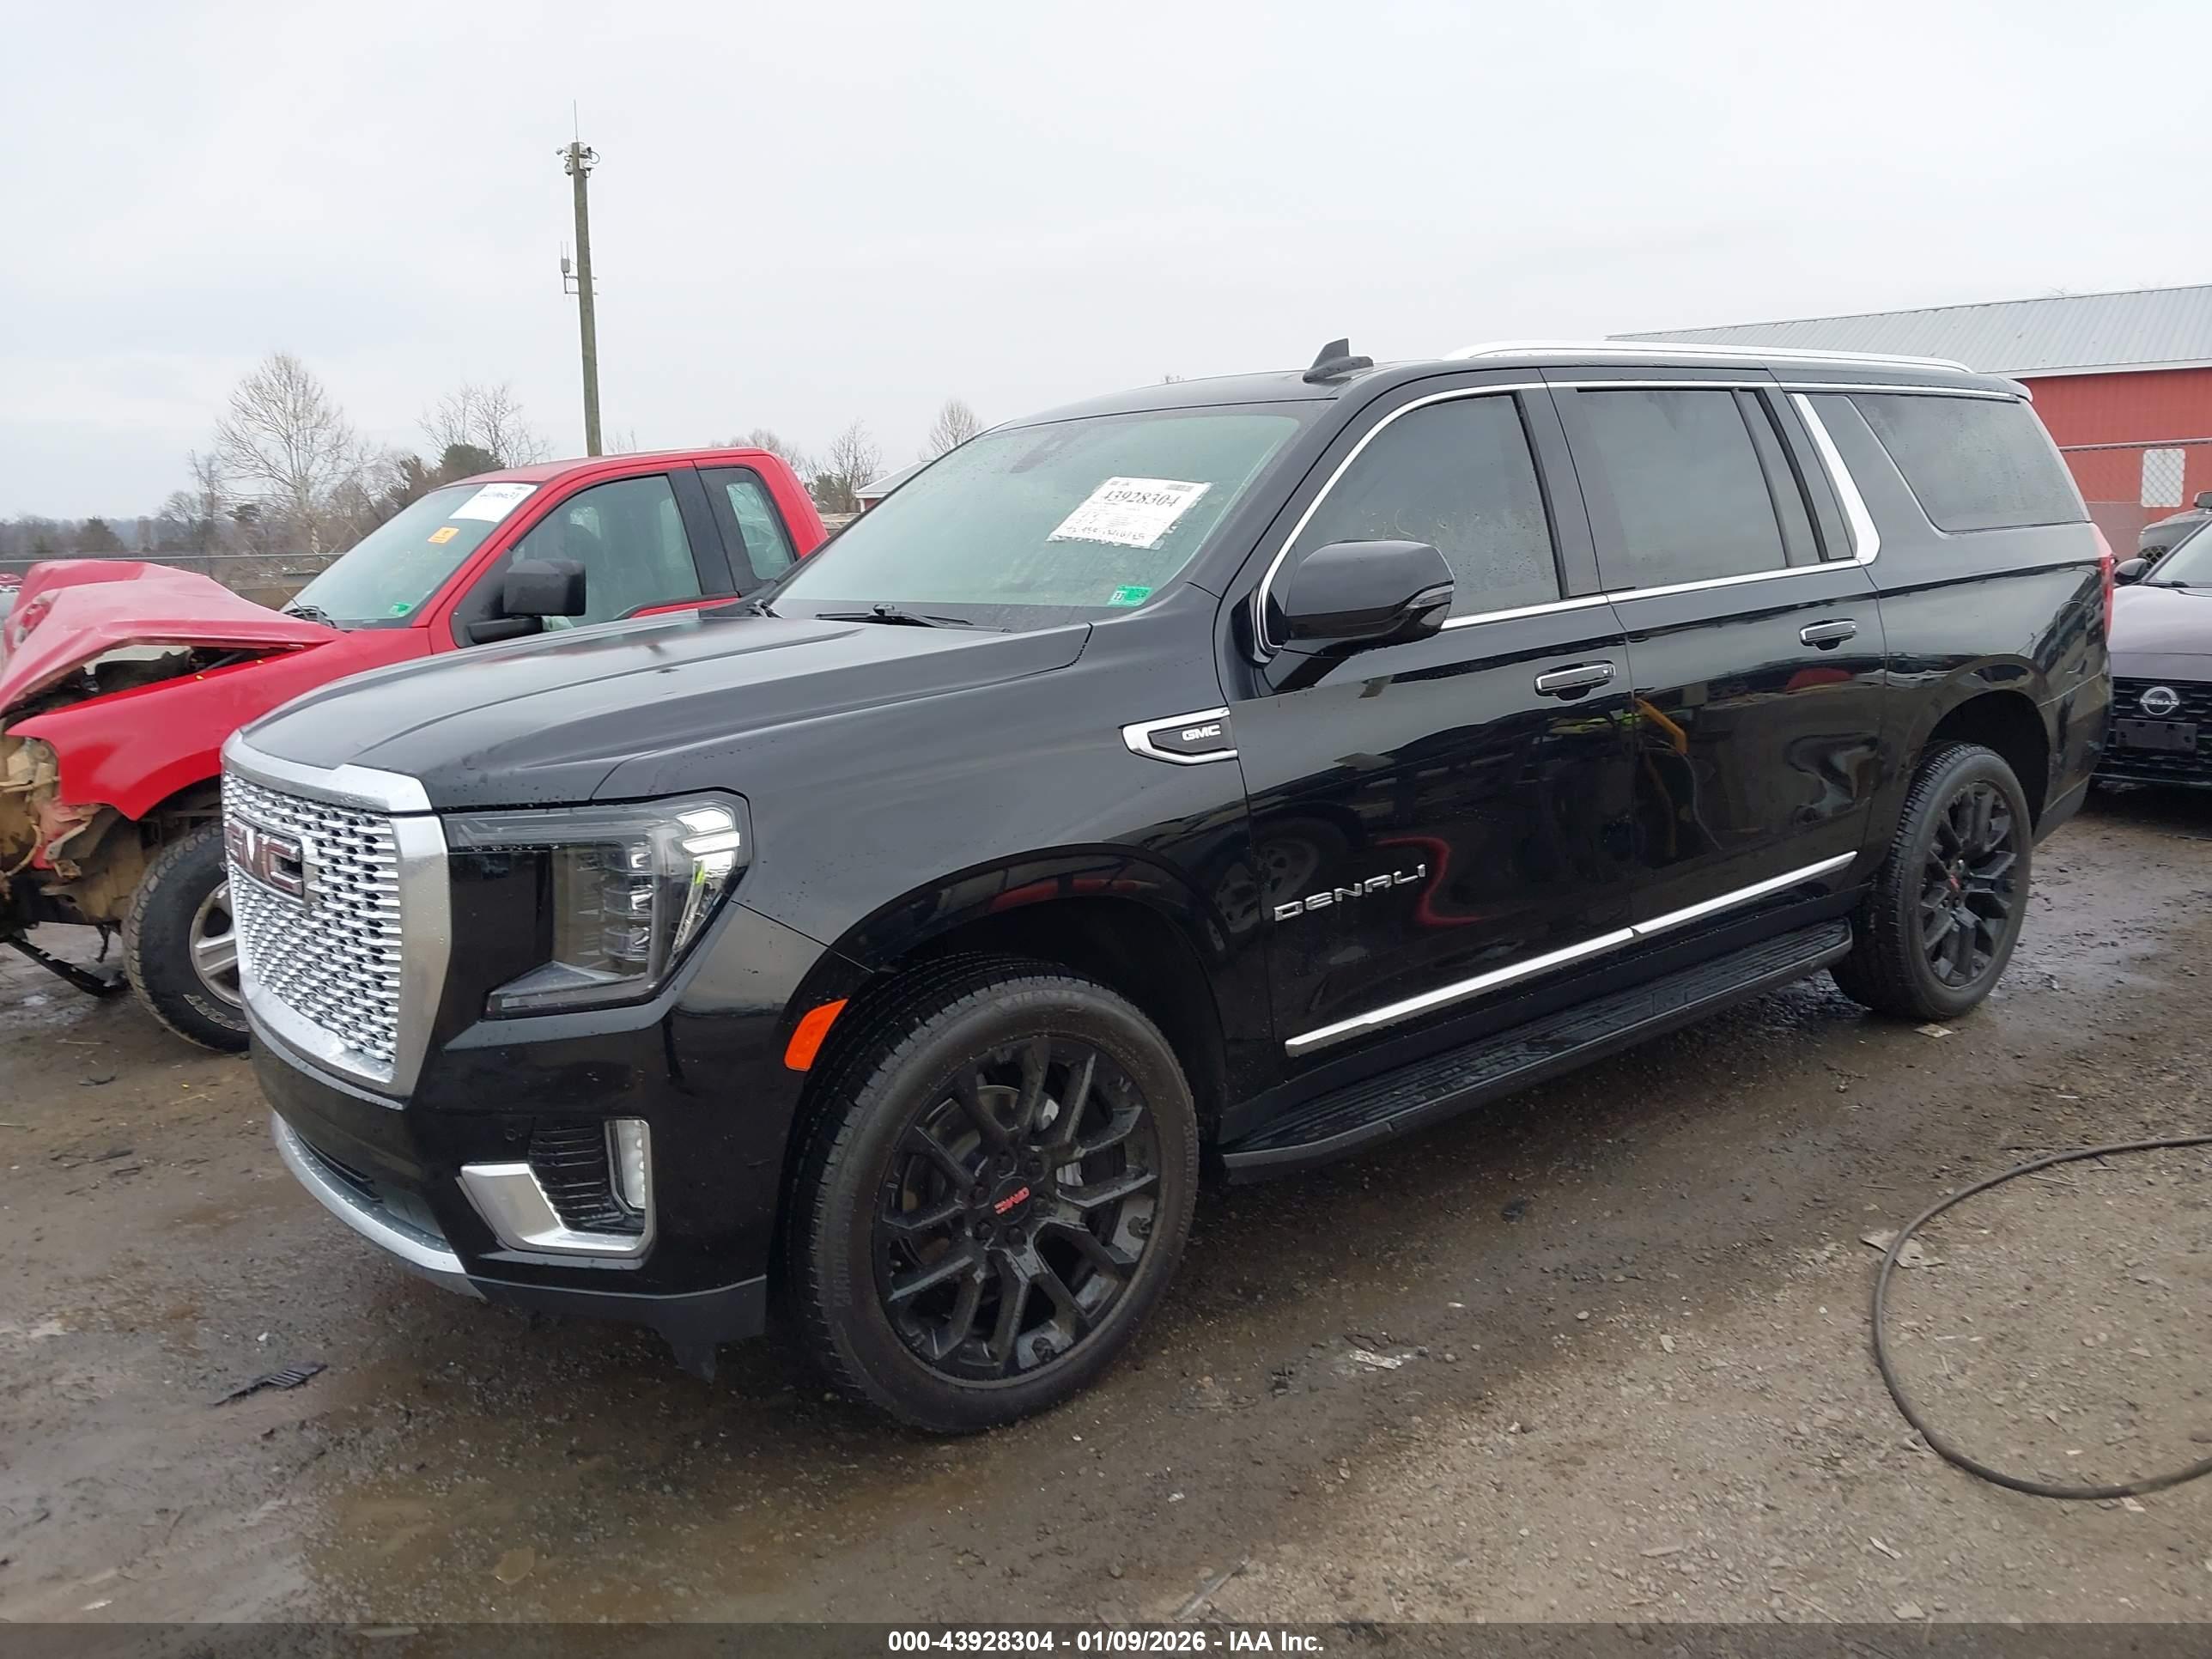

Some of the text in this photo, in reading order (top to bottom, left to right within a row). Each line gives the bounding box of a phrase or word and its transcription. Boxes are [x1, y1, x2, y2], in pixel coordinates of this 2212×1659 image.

[1181, 724, 1222, 742] GMC
[223, 817, 303, 896] GMC
[1273, 863, 1426, 921] DENALI
[994, 1186, 1030, 1215] GMC
